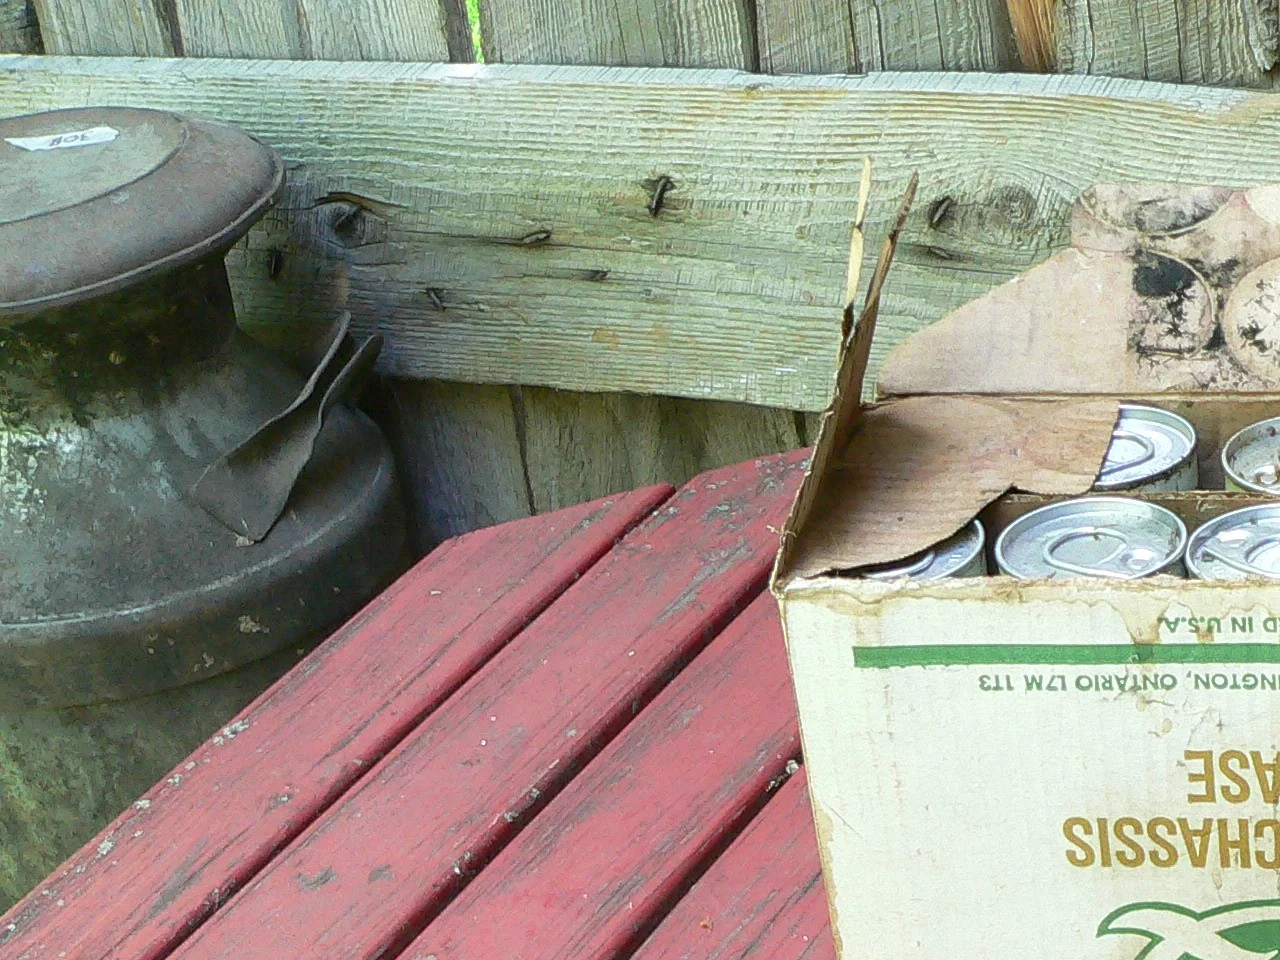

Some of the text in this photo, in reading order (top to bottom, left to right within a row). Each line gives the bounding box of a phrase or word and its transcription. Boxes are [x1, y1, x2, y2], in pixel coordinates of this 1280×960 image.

[1156, 616, 1221, 633] U.S.A.
[1231, 617, 1254, 633] IN
[978, 674, 1014, 691] 1T3
[1023, 674, 1066, 691] L7M
[1076, 674, 1178, 691] ONTARIO
